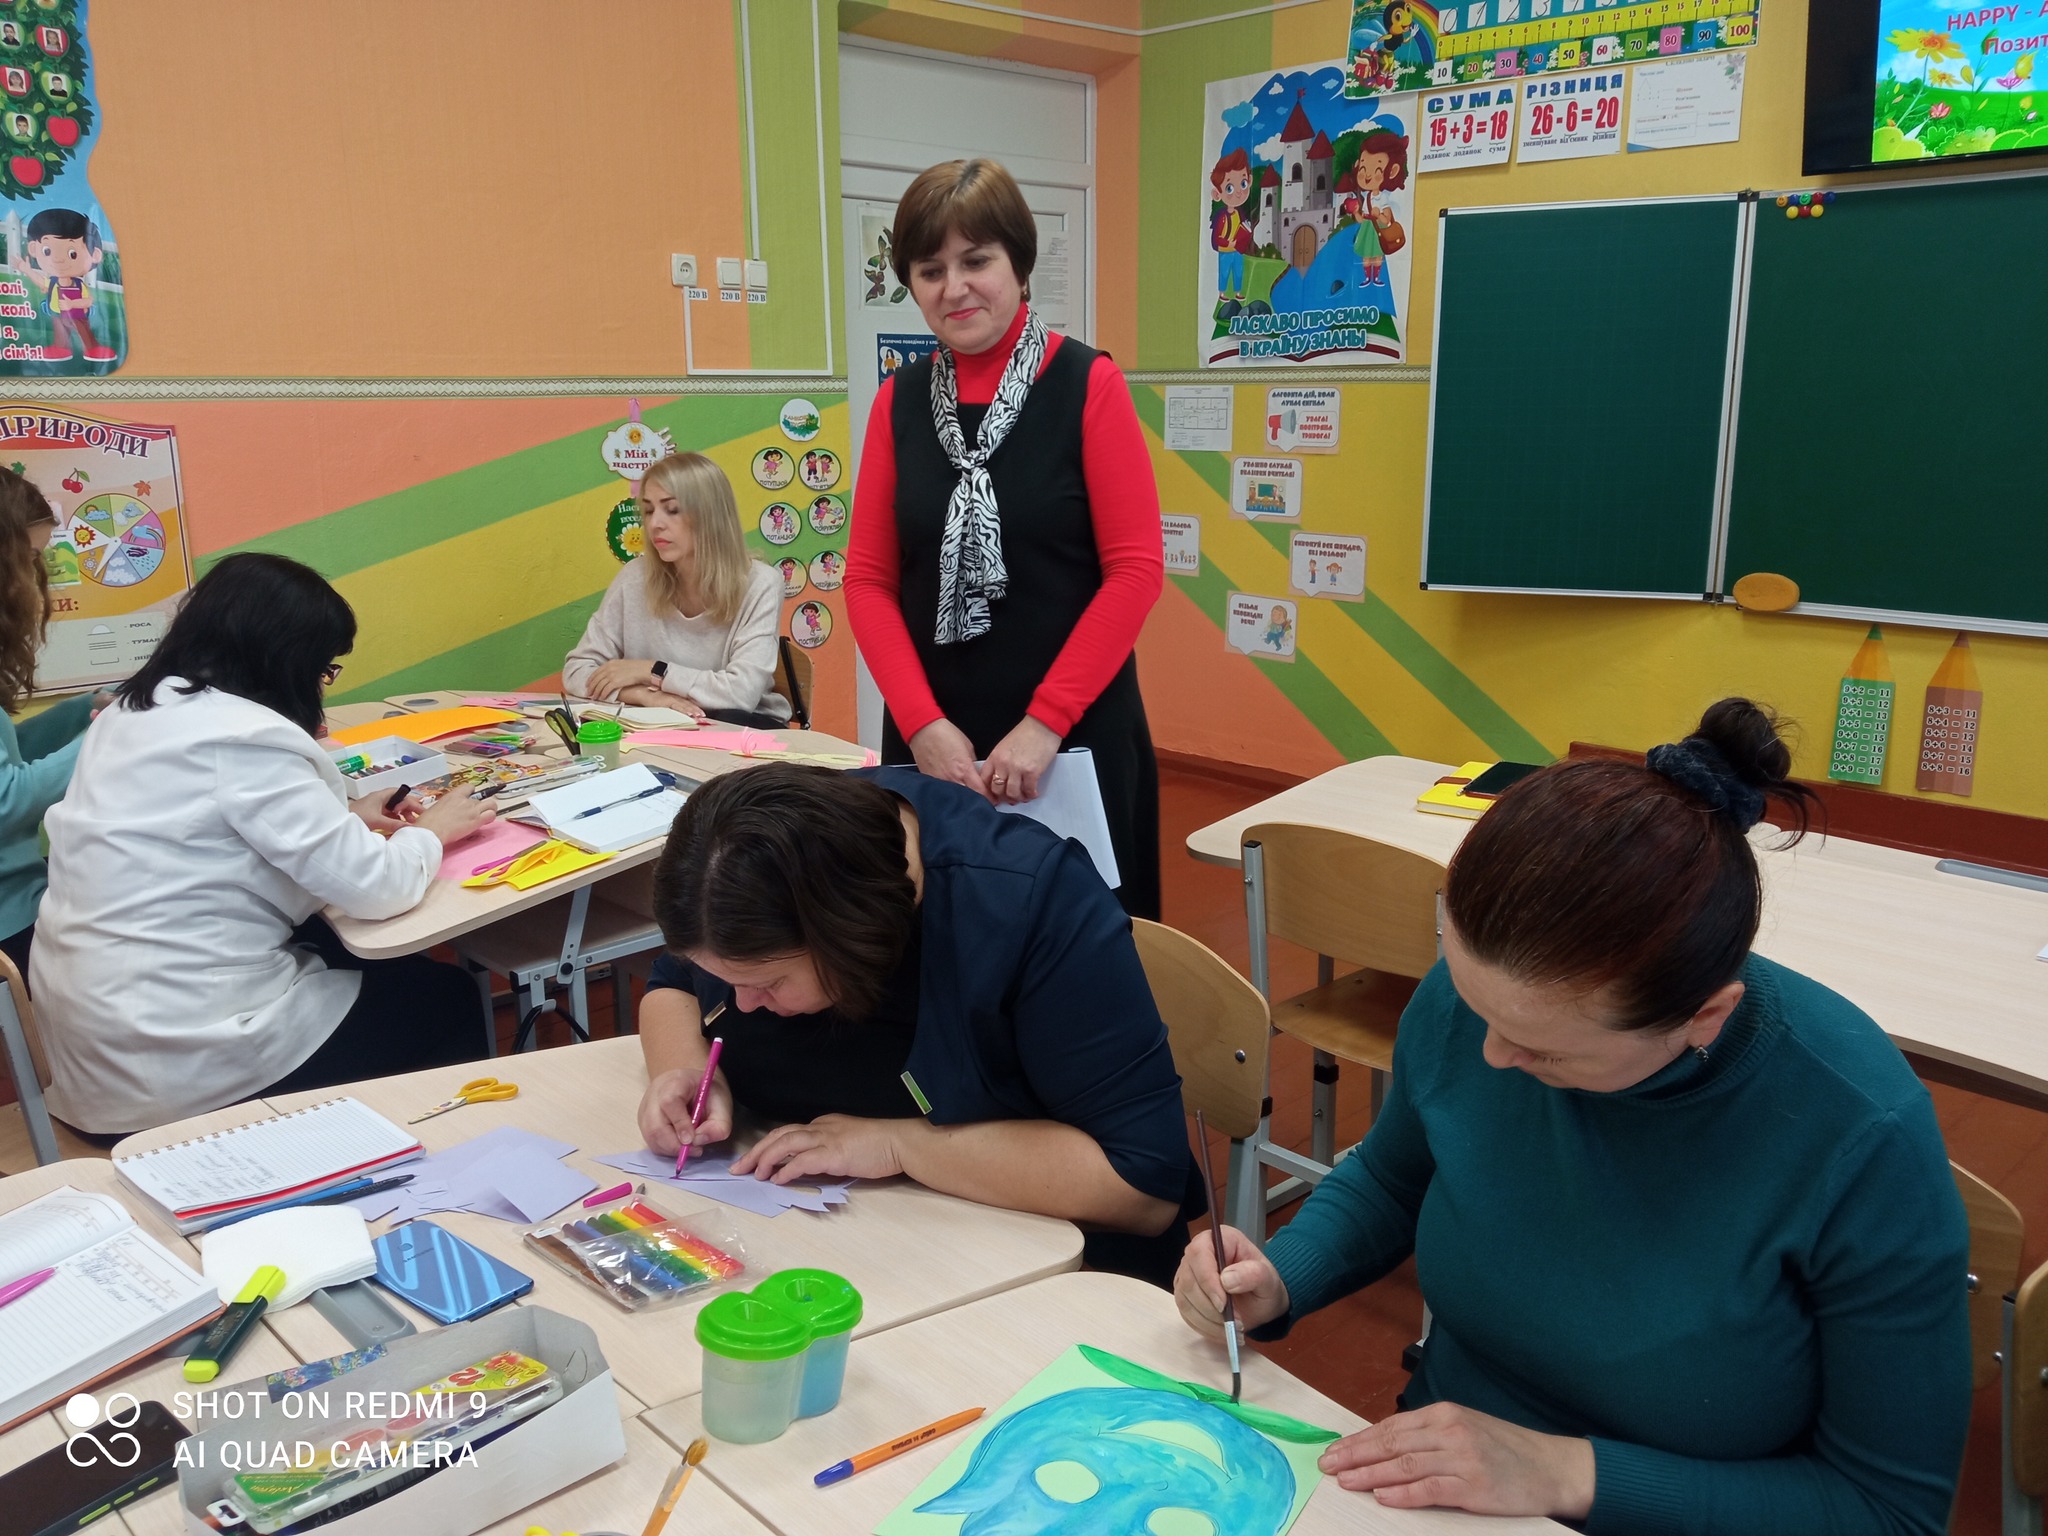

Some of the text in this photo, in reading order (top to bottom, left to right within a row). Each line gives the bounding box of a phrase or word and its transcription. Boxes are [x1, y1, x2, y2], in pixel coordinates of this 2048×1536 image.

[1947, 4, 2019, 31] HAPPY
[1699, 29, 1711, 41] 90
[1730, 24, 1750, 37] 100
[1630, 39, 1642, 51] 70
[1664, 35, 1677, 46] 80
[1563, 49, 1575, 60] 50
[1597, 44, 1608, 55] 60
[1533, 53, 1544, 63] 40
[1468, 63, 1478, 73] 20
[1500, 58, 1512, 69] 30
[1437, 67, 1448, 78] 10
[1526, 73, 1623, 99] РІЗНИЦЯ
[1428, 88, 1514, 114] СУМА
[1523, 139, 1558, 147] зменшуване
[1592, 133, 1616, 142] різниця
[1423, 145, 1506, 161] доданок доданок сума
[0, 279, 28, 298] олі,
[688, 289, 701, 299] 220
[721, 292, 734, 300] 220
[747, 293, 759, 302] 220
[1, 301, 36, 319] колі,
[1229, 306, 1379, 335] ЛАСКАВО ПРОСИМО
[4, 326, 18, 340] я,
[1239, 341, 1250, 357] В
[1252, 335, 1310, 357] КРАЇНУ
[4, 344, 43, 360] сім'я!
[624, 449, 649, 459] Мій
[613, 460, 657, 471] настрі
[1243, 461, 1268, 469] УВАЖНО
[1879, 689, 1890, 697] 11
[1878, 700, 1889, 709] 12
[1876, 711, 1888, 720] 13
[1965, 709, 1977, 718] 11
[1875, 723, 1886, 731] 14
[1964, 721, 1976, 730] 12
[1873, 734, 1885, 742] 15
[1963, 732, 1974, 742] 13
[1871, 745, 1883, 754] 16
[1961, 744, 1973, 753] 14
[1870, 756, 1882, 765] 17
[1960, 755, 1972, 764] 15
[1868, 767, 1880, 776] 18
[1958, 767, 1971, 776] 16
